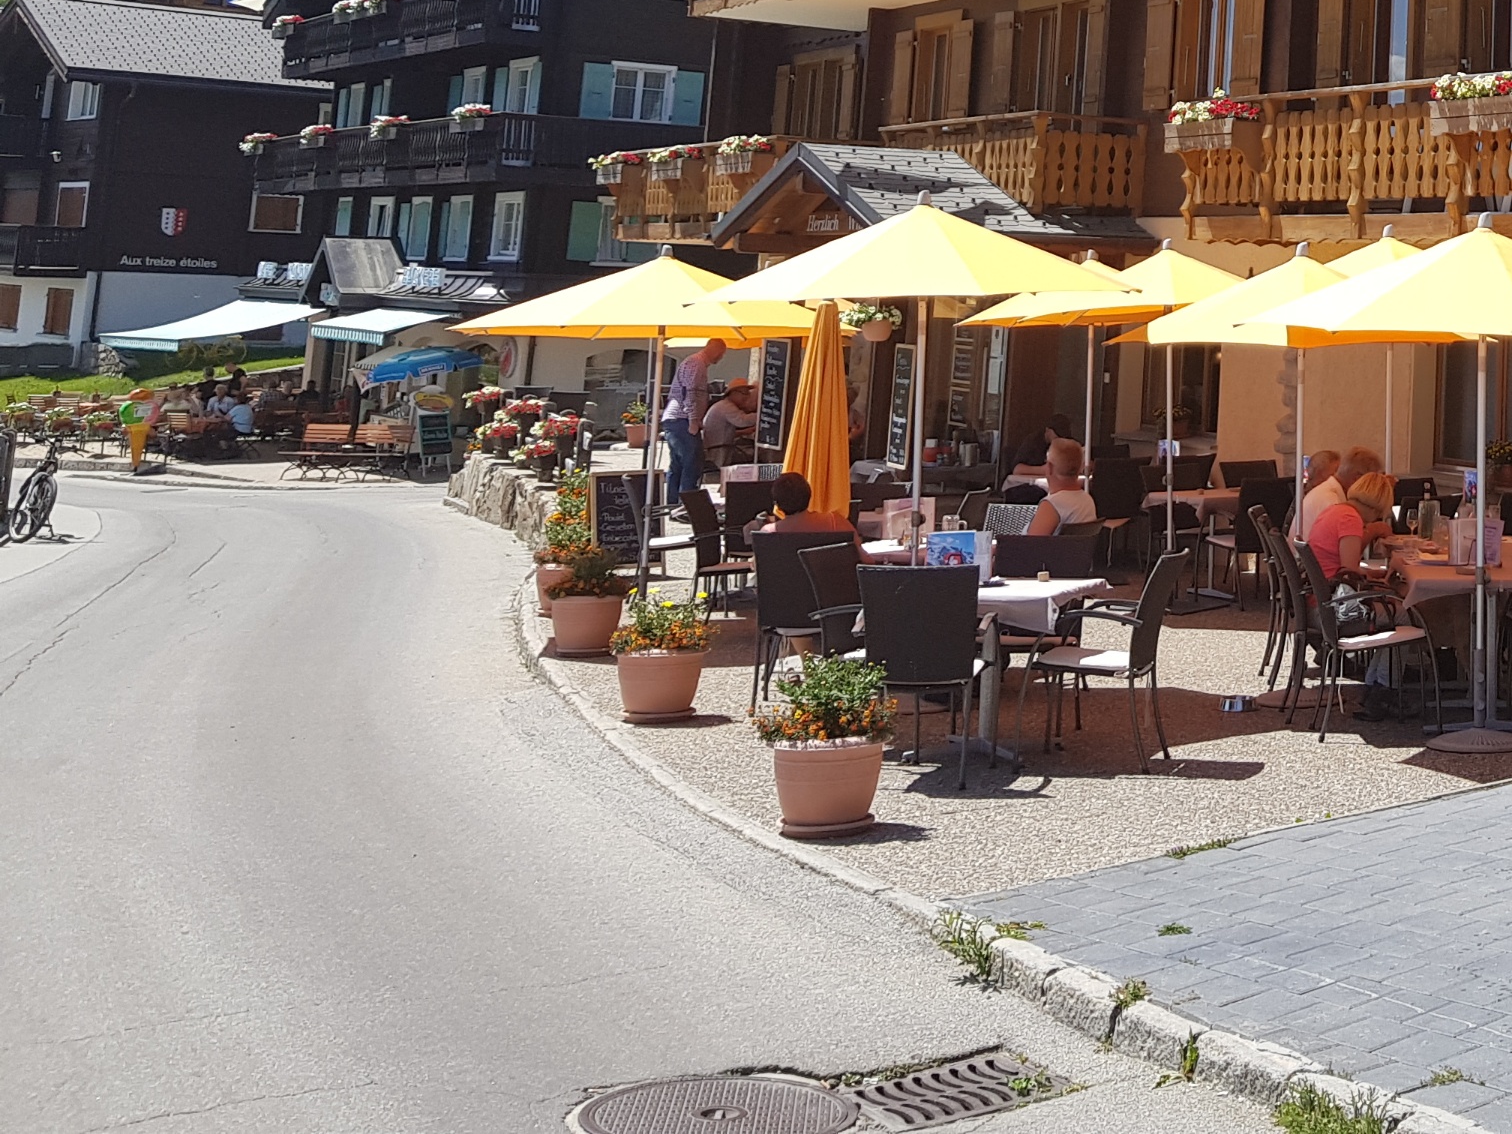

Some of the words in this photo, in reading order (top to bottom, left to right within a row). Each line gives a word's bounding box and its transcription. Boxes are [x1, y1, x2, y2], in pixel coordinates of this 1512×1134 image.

[806, 214, 839, 231] Herzlich
[120, 255, 142, 266] Aux
[145, 256, 176, 267] treize
[180, 257, 218, 268] étoiles
